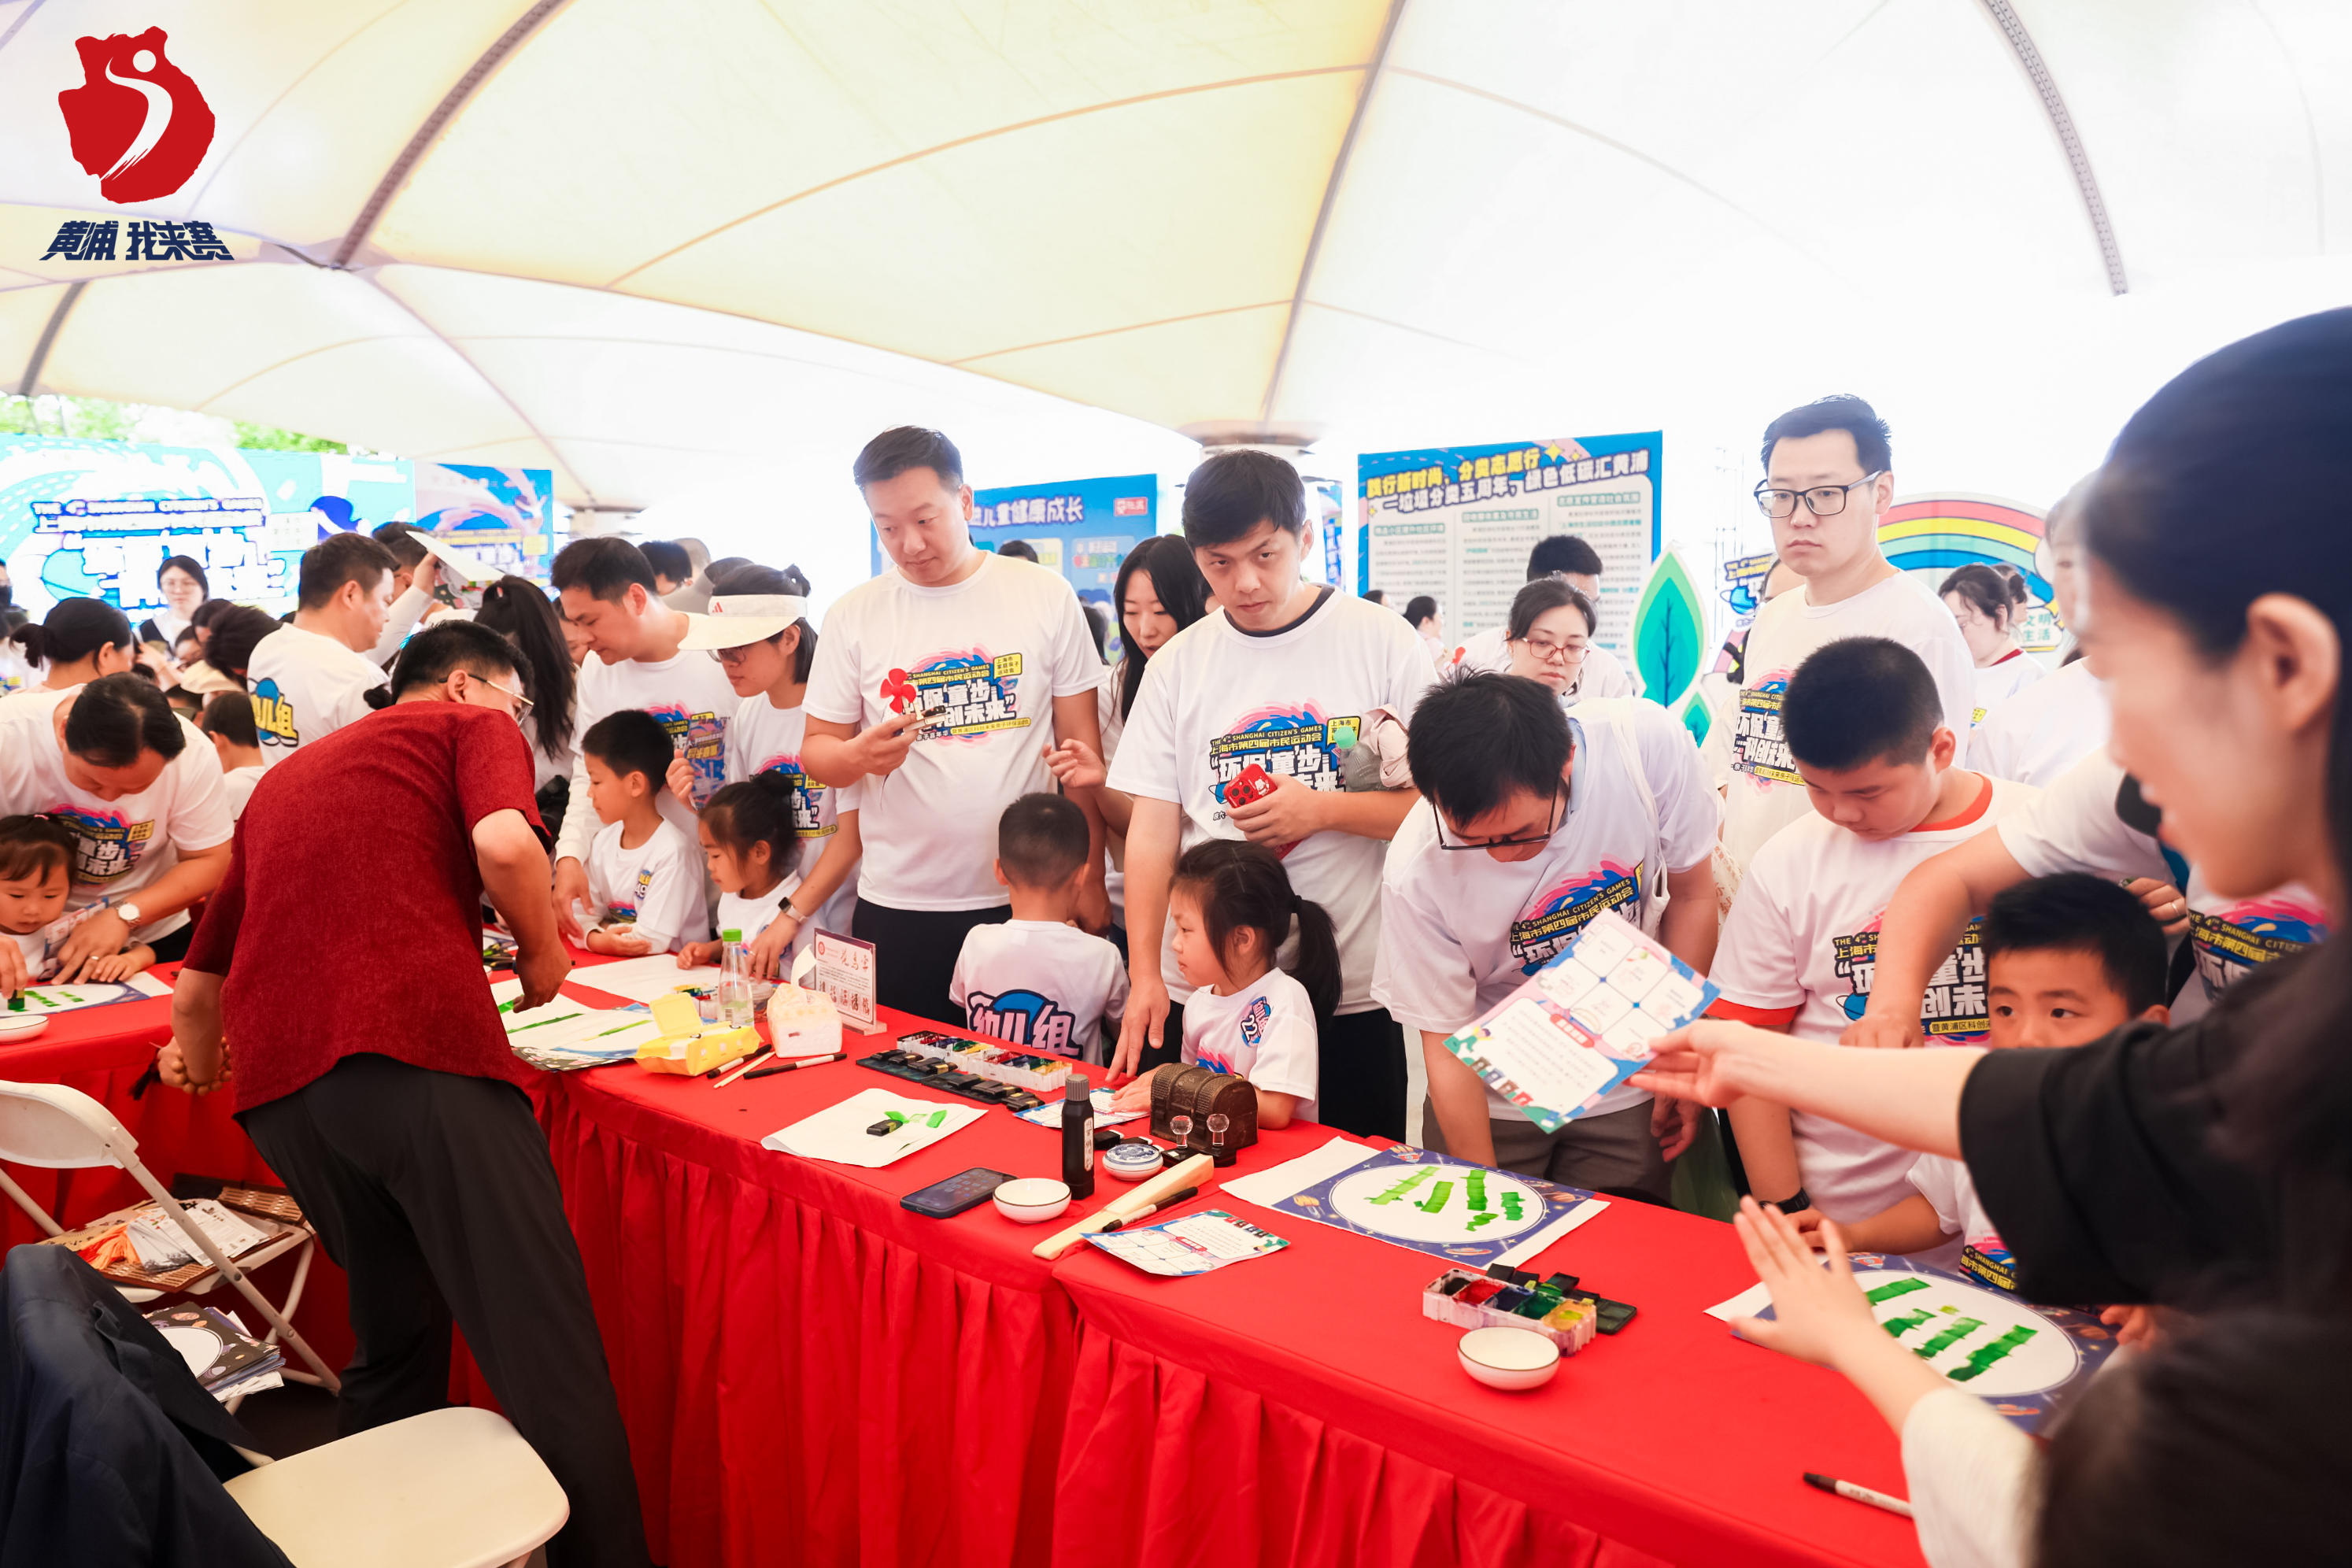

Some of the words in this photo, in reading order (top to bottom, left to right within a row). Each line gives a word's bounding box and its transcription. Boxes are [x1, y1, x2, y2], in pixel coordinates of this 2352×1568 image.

[2025, 613, 2052, 627] 文明
[2024, 628, 2051, 642] 生活
[912, 670, 941, 679] SHANGHAI
[943, 668, 970, 676] CITIZEN'S
[1211, 732, 1322, 755] 上海市第四届市民运动会
[1232, 733, 1265, 741] SHANGHAI
[1267, 729, 1298, 738] CITIZEN'S
[1532, 909, 1570, 927] SHANGHAI
[1572, 893, 1604, 913] CITIZEN'S
[1607, 878, 1631, 894] GAMES
[1511, 886, 1634, 942] 上海市第四届市民运动会
[1835, 937, 1851, 946] THE
[2221, 924, 2260, 945] SHANGHAI
[1241, 1014, 1258, 1041] 22
[1974, 1252, 2008, 1275] SHANGHAI
